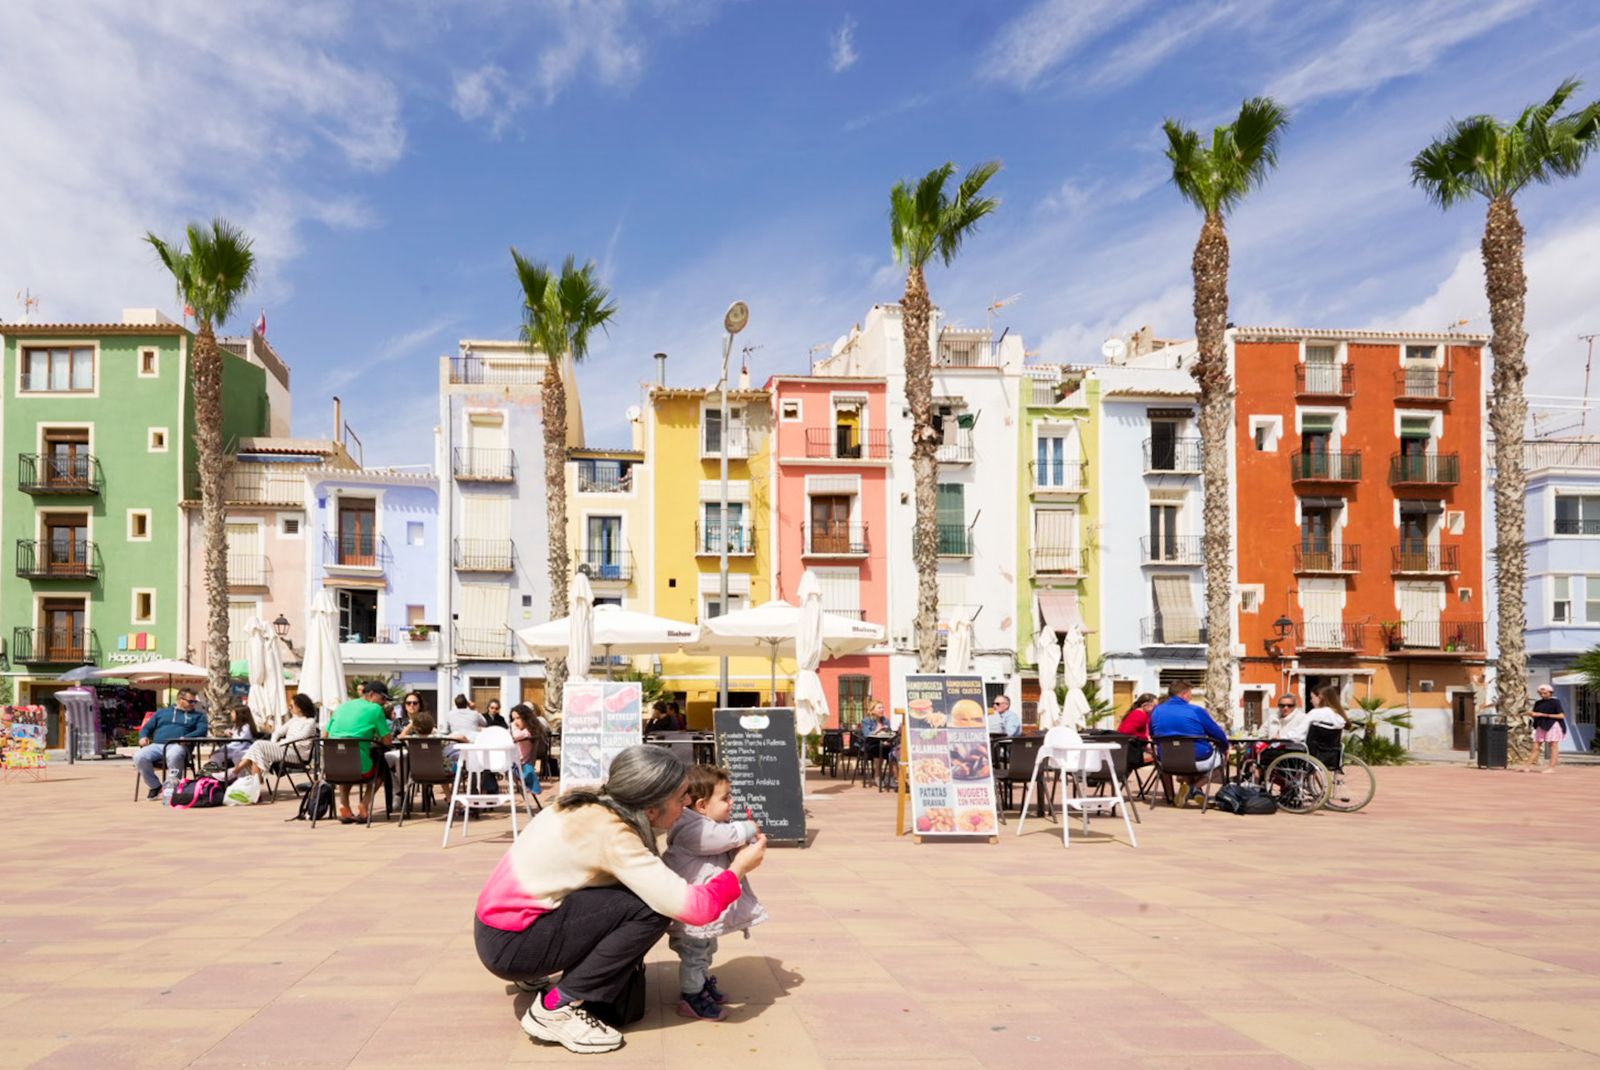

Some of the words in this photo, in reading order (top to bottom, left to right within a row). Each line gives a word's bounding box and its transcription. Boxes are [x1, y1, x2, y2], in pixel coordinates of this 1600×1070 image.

[565, 736, 598, 745] DORADA
[911, 744, 948, 754] CALAMARES
[919, 787, 948, 797] PATATAS
[956, 787, 989, 798] NUGGETS
[922, 799, 946, 807] BRAVAS
[969, 798, 991, 806] PATATAS
